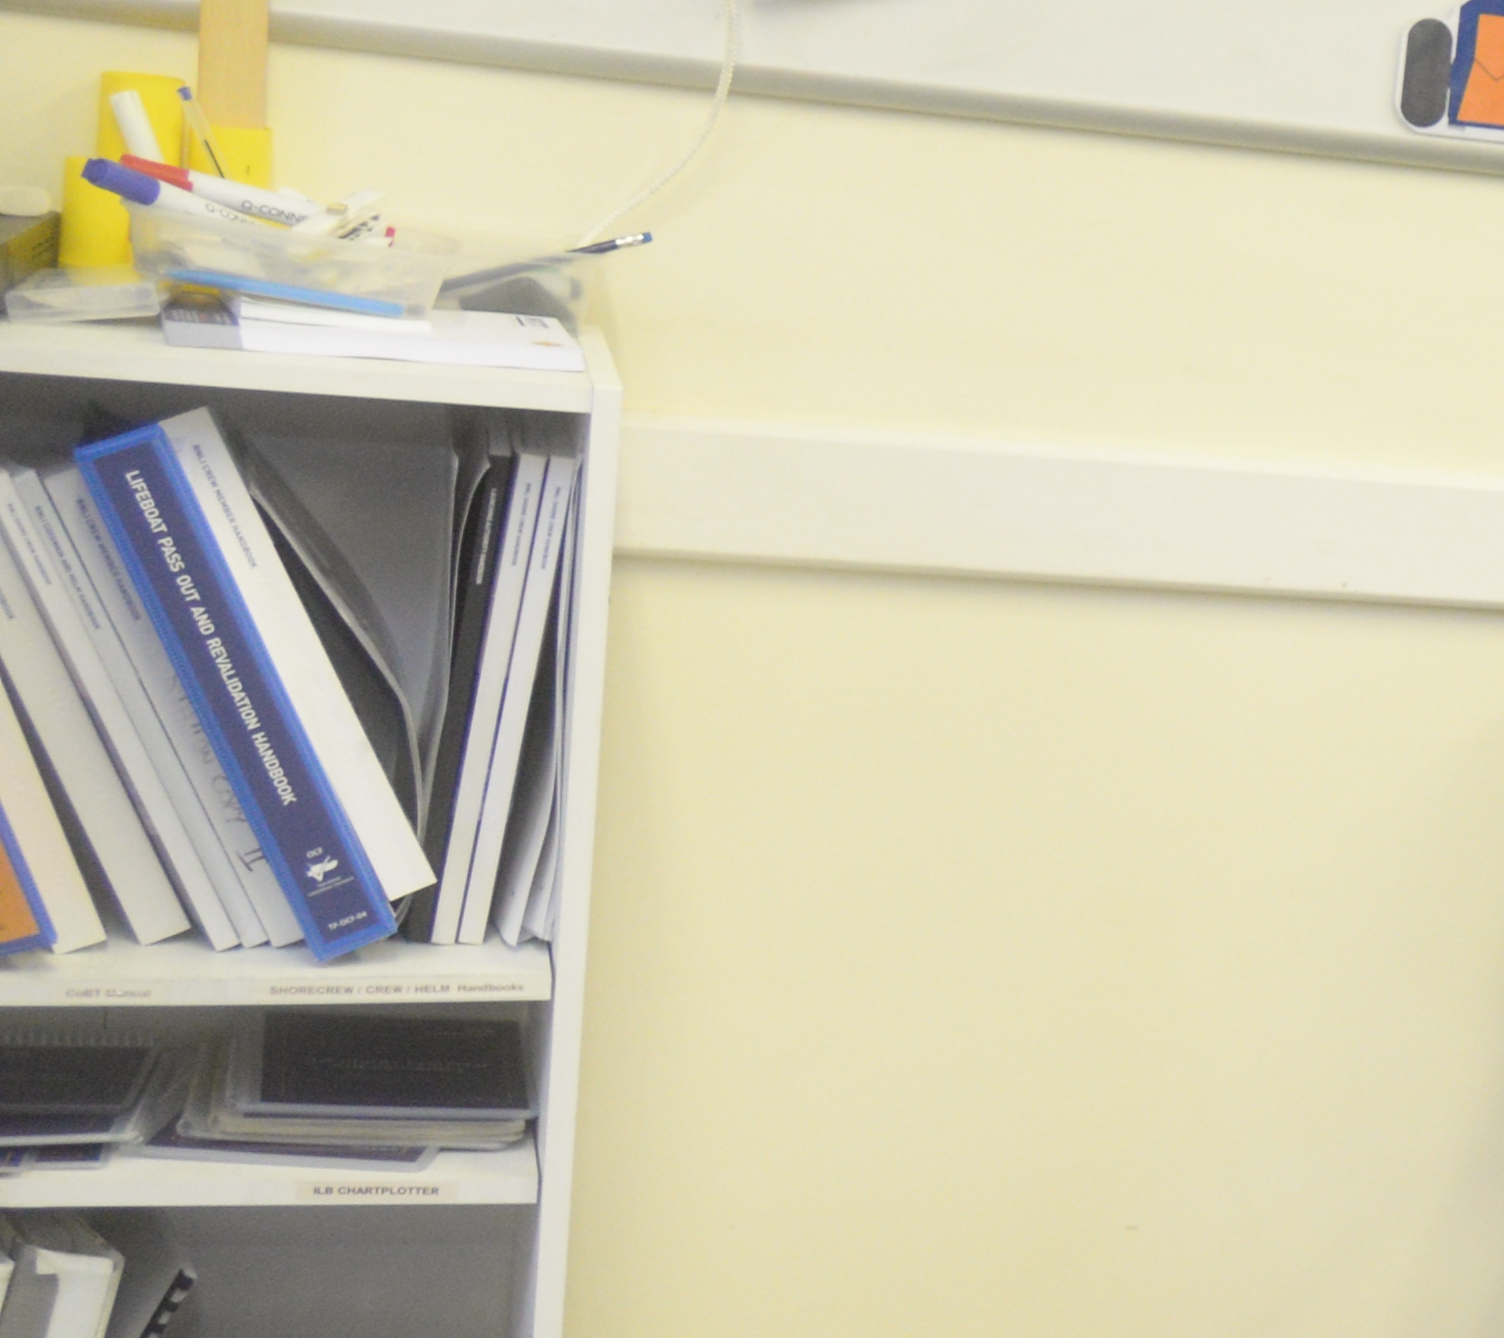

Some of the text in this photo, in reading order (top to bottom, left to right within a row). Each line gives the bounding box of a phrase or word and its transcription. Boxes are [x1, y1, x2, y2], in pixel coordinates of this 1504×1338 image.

[199, 463, 219, 489] CREW
[212, 488, 236, 525] MEMBER
[229, 523, 258, 570] HANDBOOK
[113, 577, 142, 621] HANDBOOK
[123, 468, 297, 807] LIFEBOAT PASS OUT AND REVALIDATION HANDBOOK
[269, 984, 354, 996] SHORECREW
[365, 984, 402, 996] CREW
[413, 984, 450, 994] HELM
[457, 981, 525, 993] Handbooks
[313, 1186, 440, 1196] ILB CHARTPLOTTER
